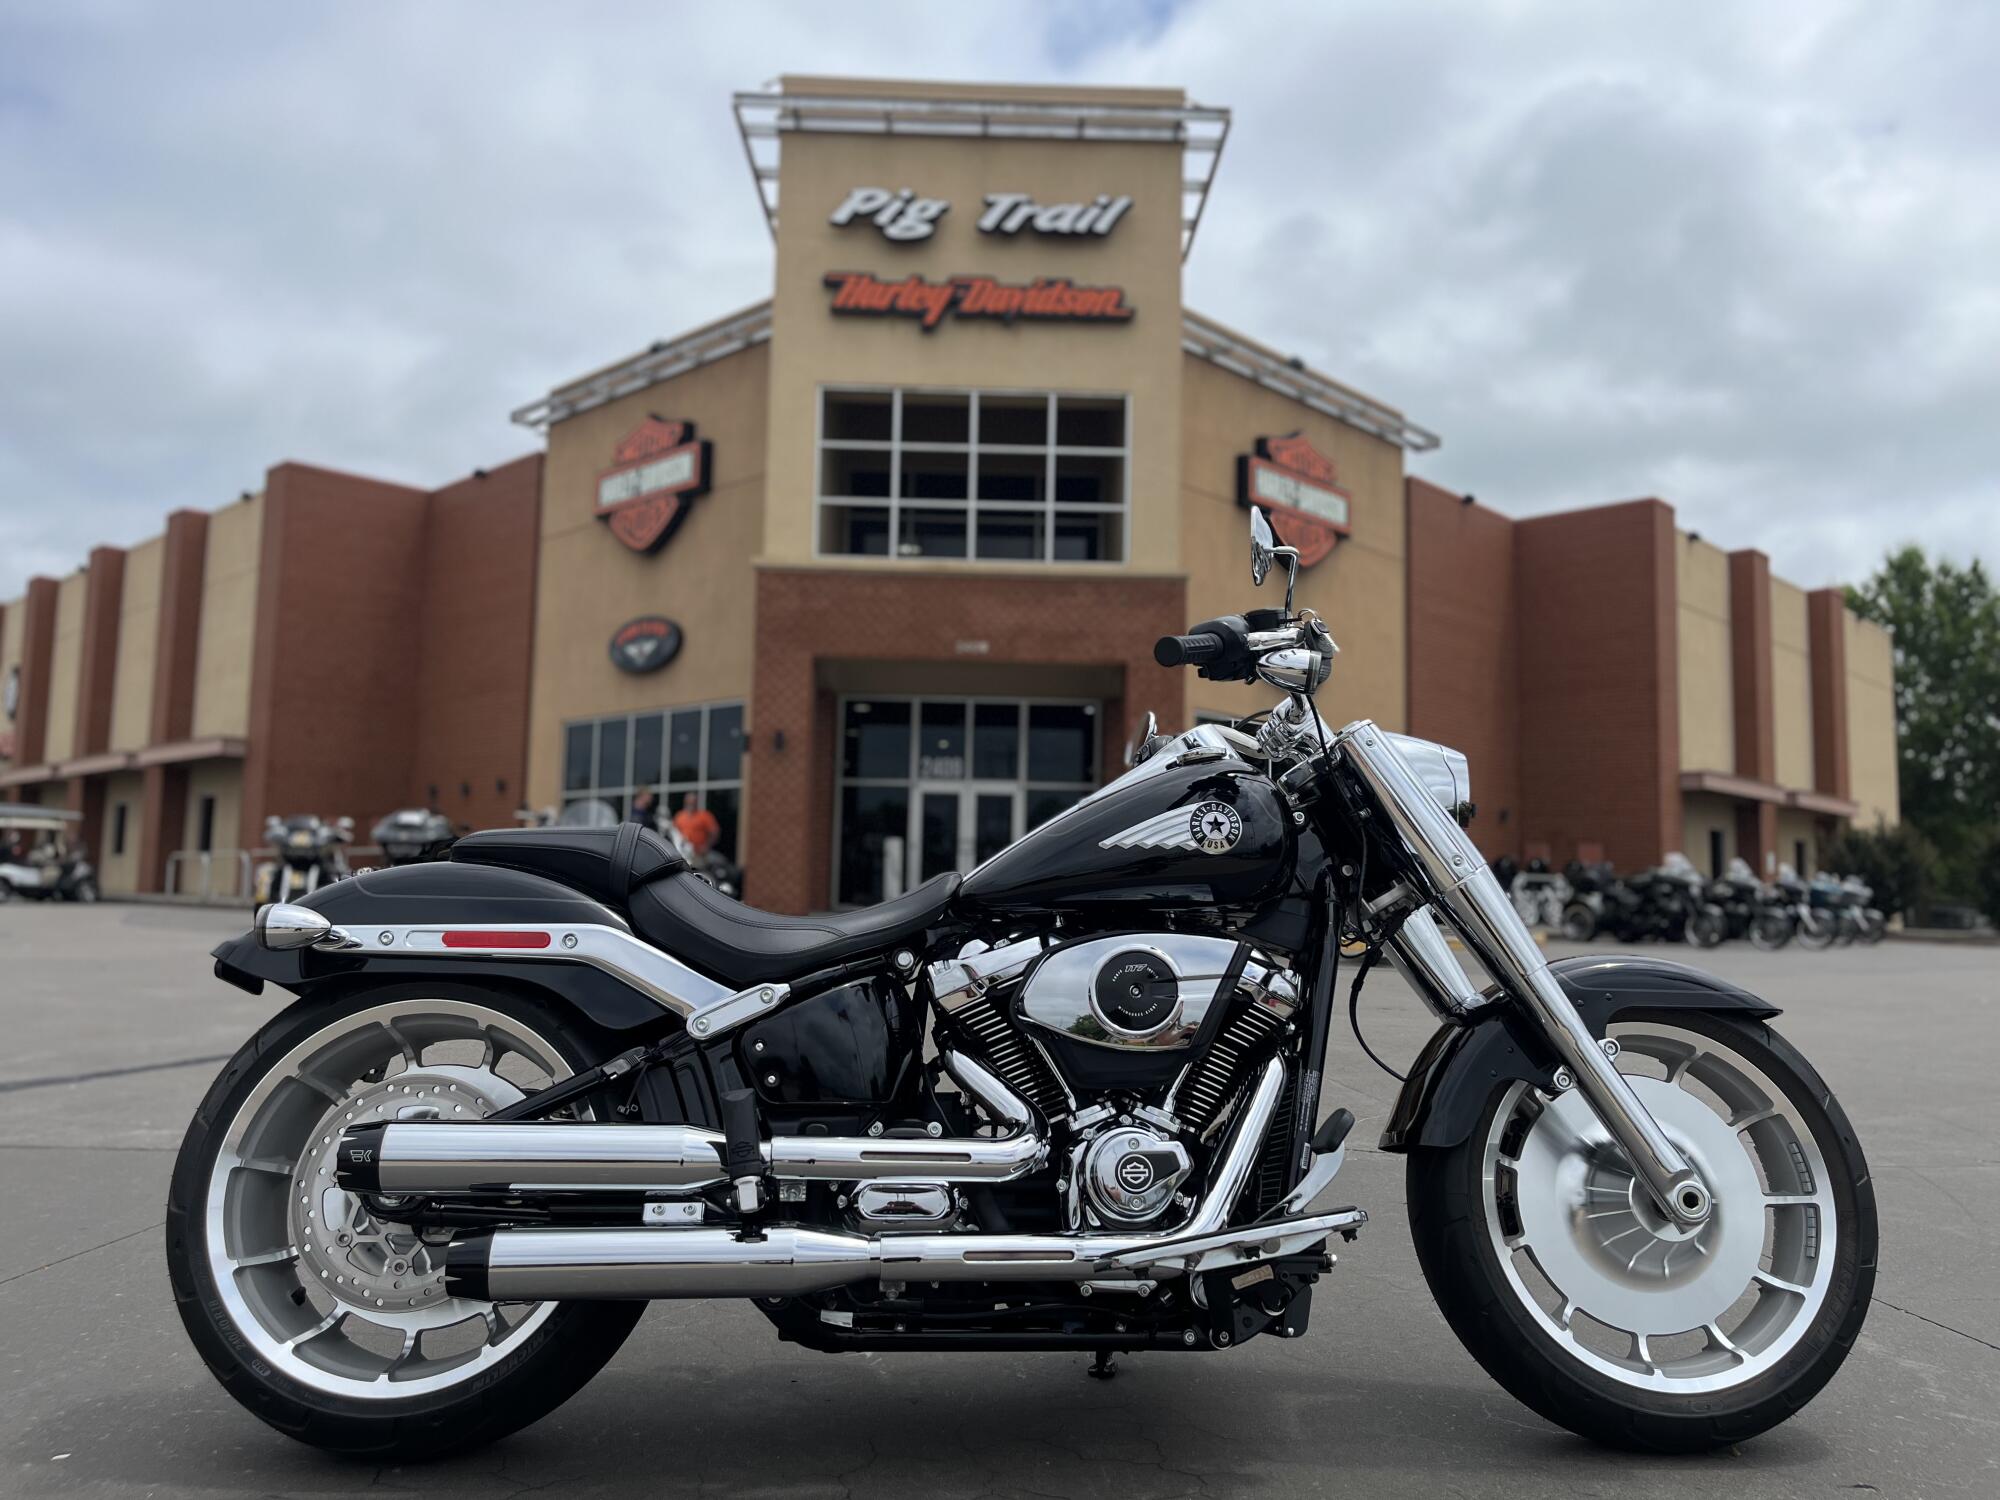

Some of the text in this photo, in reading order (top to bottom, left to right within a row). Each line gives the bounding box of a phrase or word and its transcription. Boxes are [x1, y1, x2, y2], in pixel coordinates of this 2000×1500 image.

[829, 187, 1133, 241] Pig Trail
[1191, 803, 1239, 841] HARLEY-DAVIDSON
[1207, 840, 1225, 849] USA
